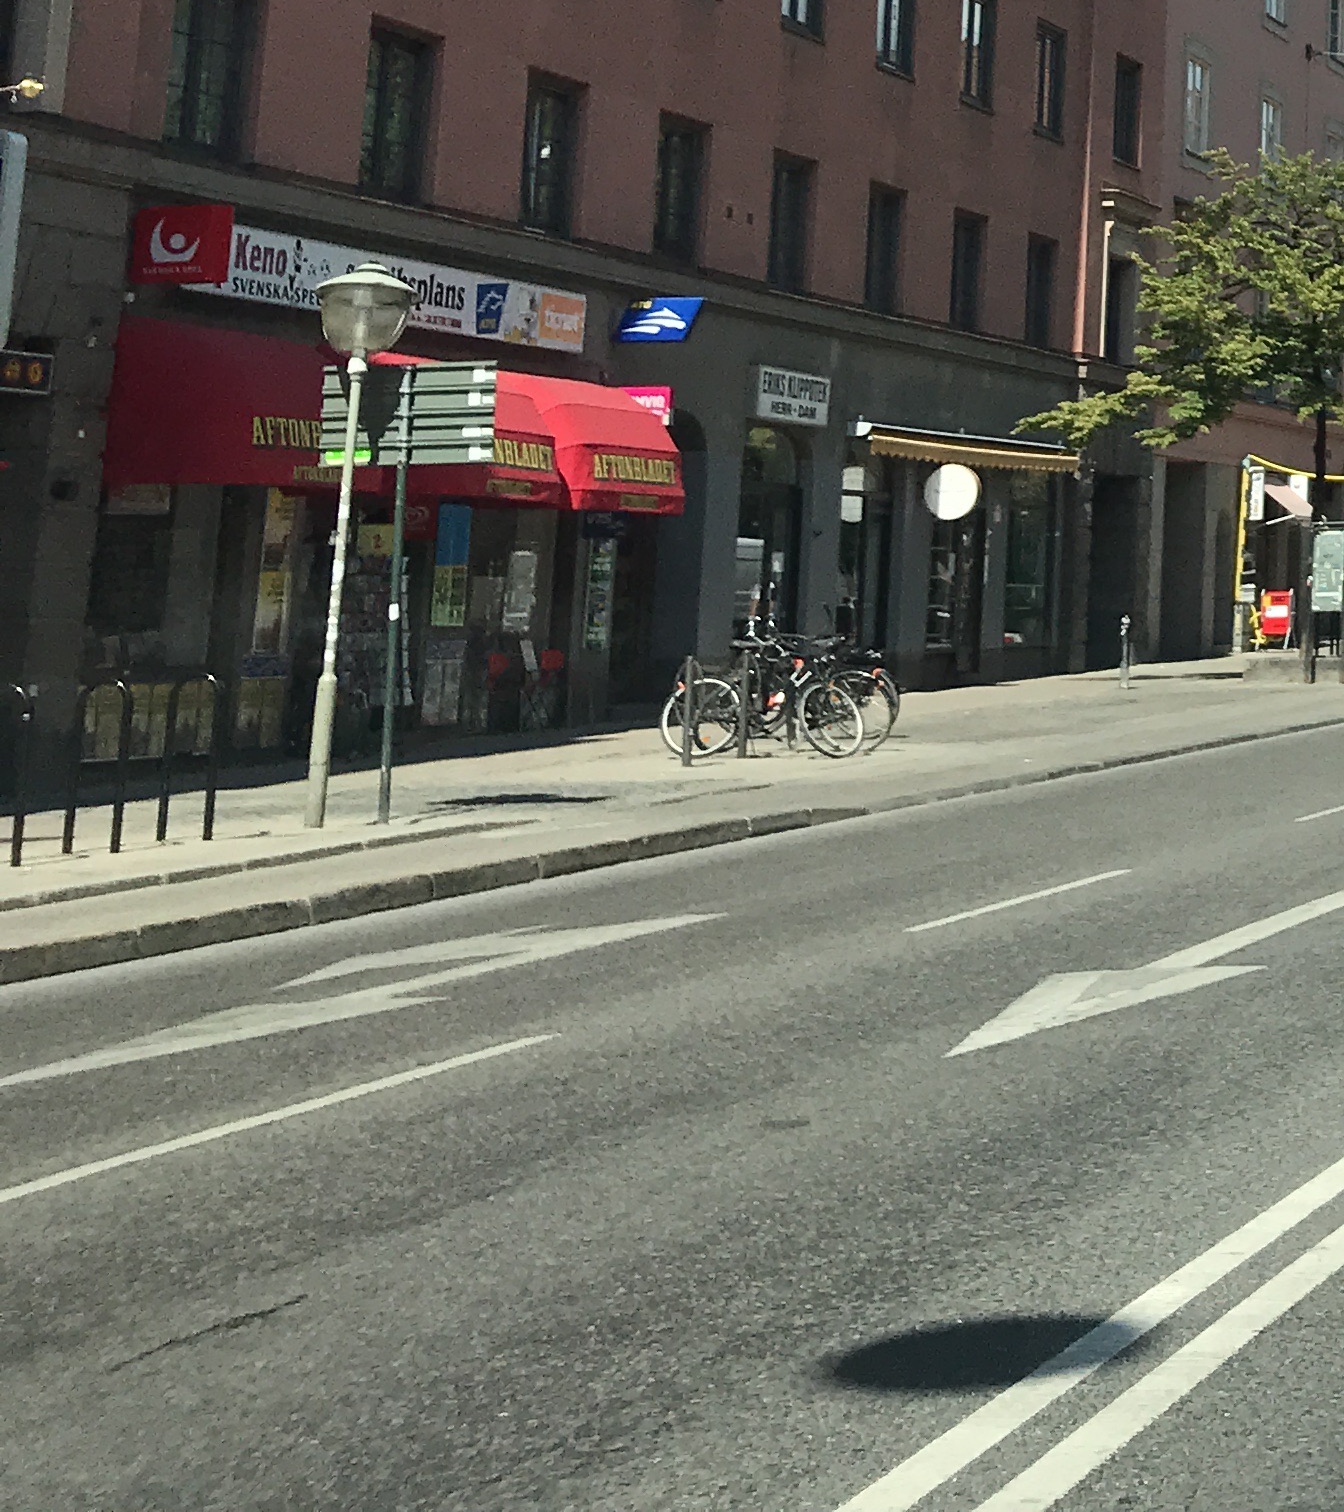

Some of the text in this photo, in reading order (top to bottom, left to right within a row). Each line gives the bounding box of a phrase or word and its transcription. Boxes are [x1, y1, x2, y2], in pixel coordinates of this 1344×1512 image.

[233, 233, 288, 278] Keno
[232, 276, 291, 301] SVENSKA
[252, 416, 322, 449] AFTONB
[494, 438, 554, 471] NBLADET
[593, 453, 676, 485] AFTONBLADET
